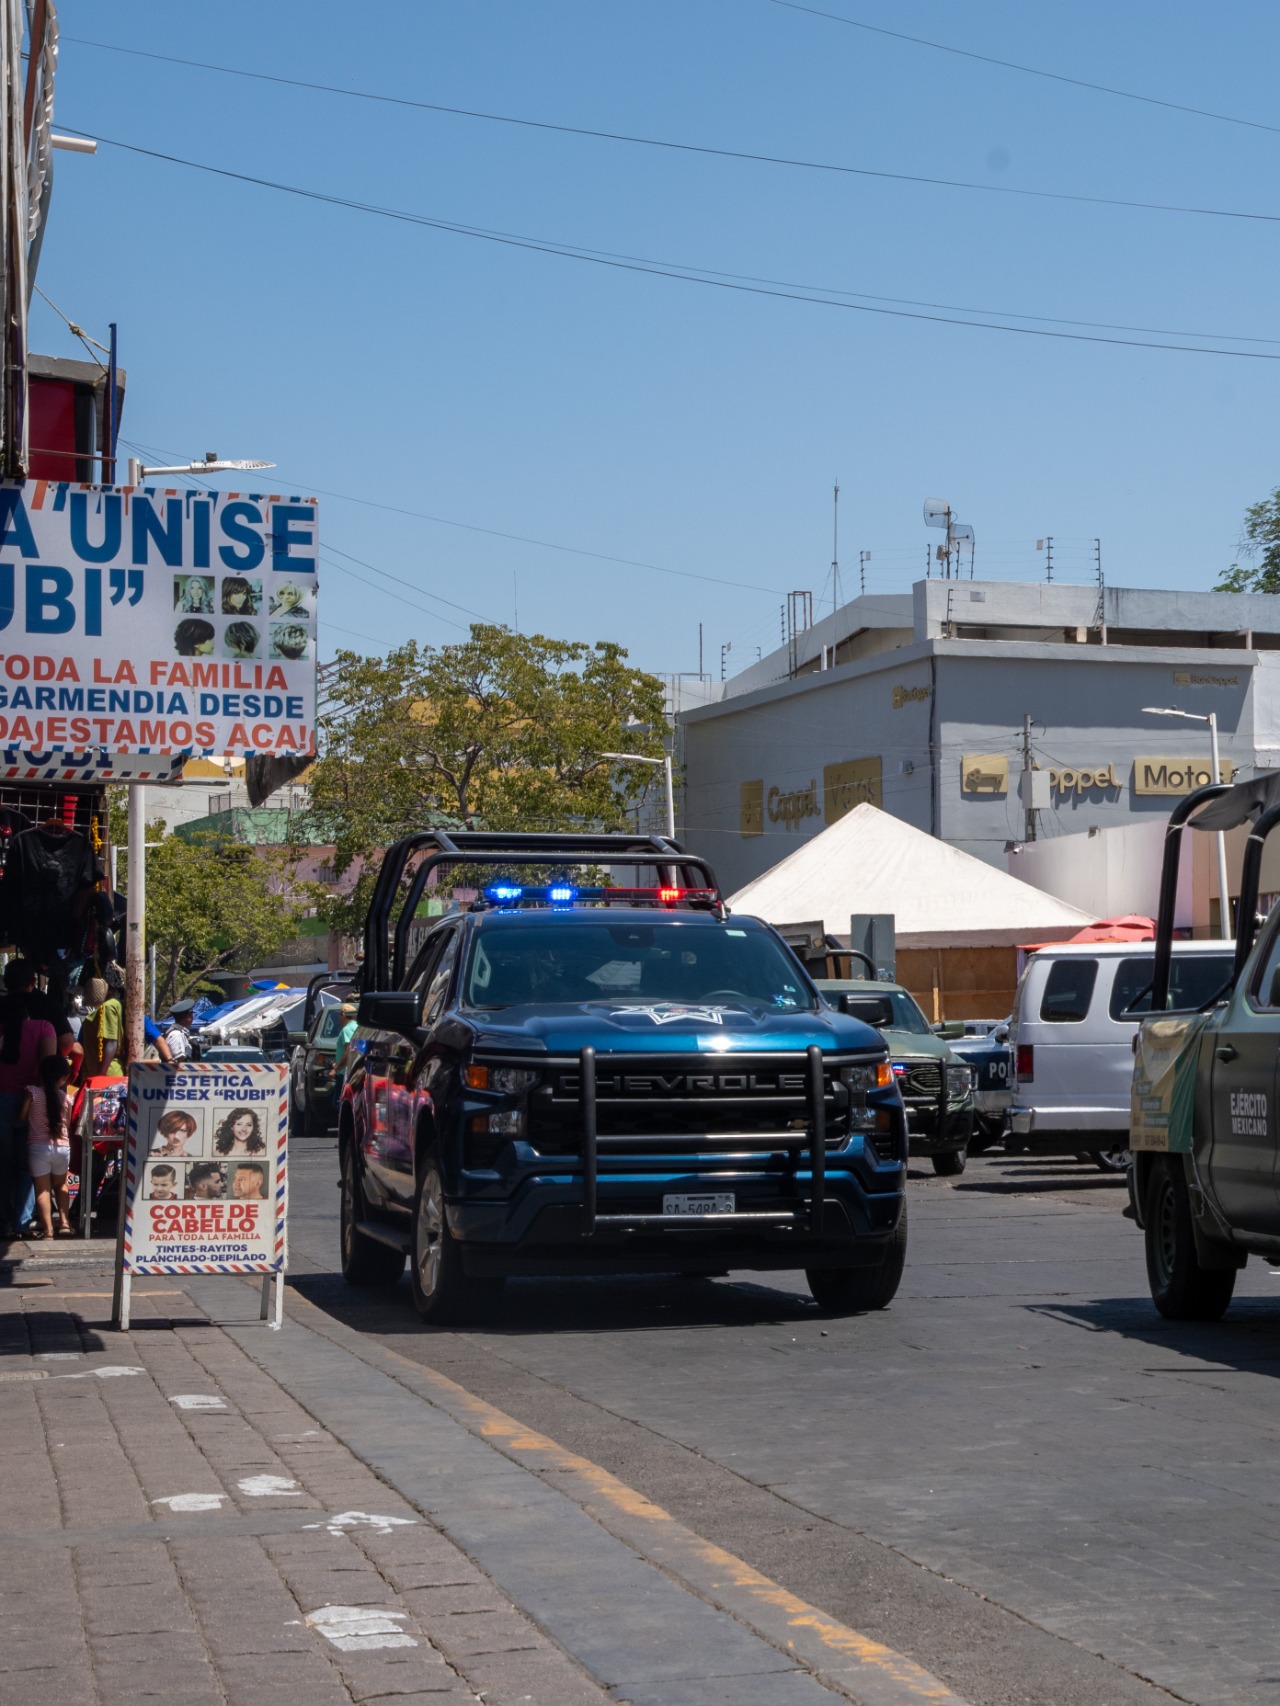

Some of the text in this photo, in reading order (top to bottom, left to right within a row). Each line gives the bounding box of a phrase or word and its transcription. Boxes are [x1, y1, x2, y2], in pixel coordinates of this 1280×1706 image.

[0, 563, 144, 637] BI”
[0, 654, 288, 690] ODA LA FAMILIA
[200, 693, 303, 719] DESDE
[227, 722, 307, 749] ACA!
[165, 1075, 253, 1087] ESTETICA
[143, 1089, 275, 1101] UNISEX “RUBI”
[1230, 1088, 1267, 1118] EJÉRCITO
[1231, 1117, 1267, 1137] MEXICANO
[150, 1204, 259, 1219] CORTE DE
[152, 1218, 255, 1233] CABELLO
[222, 1232, 261, 1240] FAMILIA
[156, 1244, 248, 1253] TINTES-RAYITOS
[136, 1253, 267, 1263] PLANCHADO-DEPILADO
